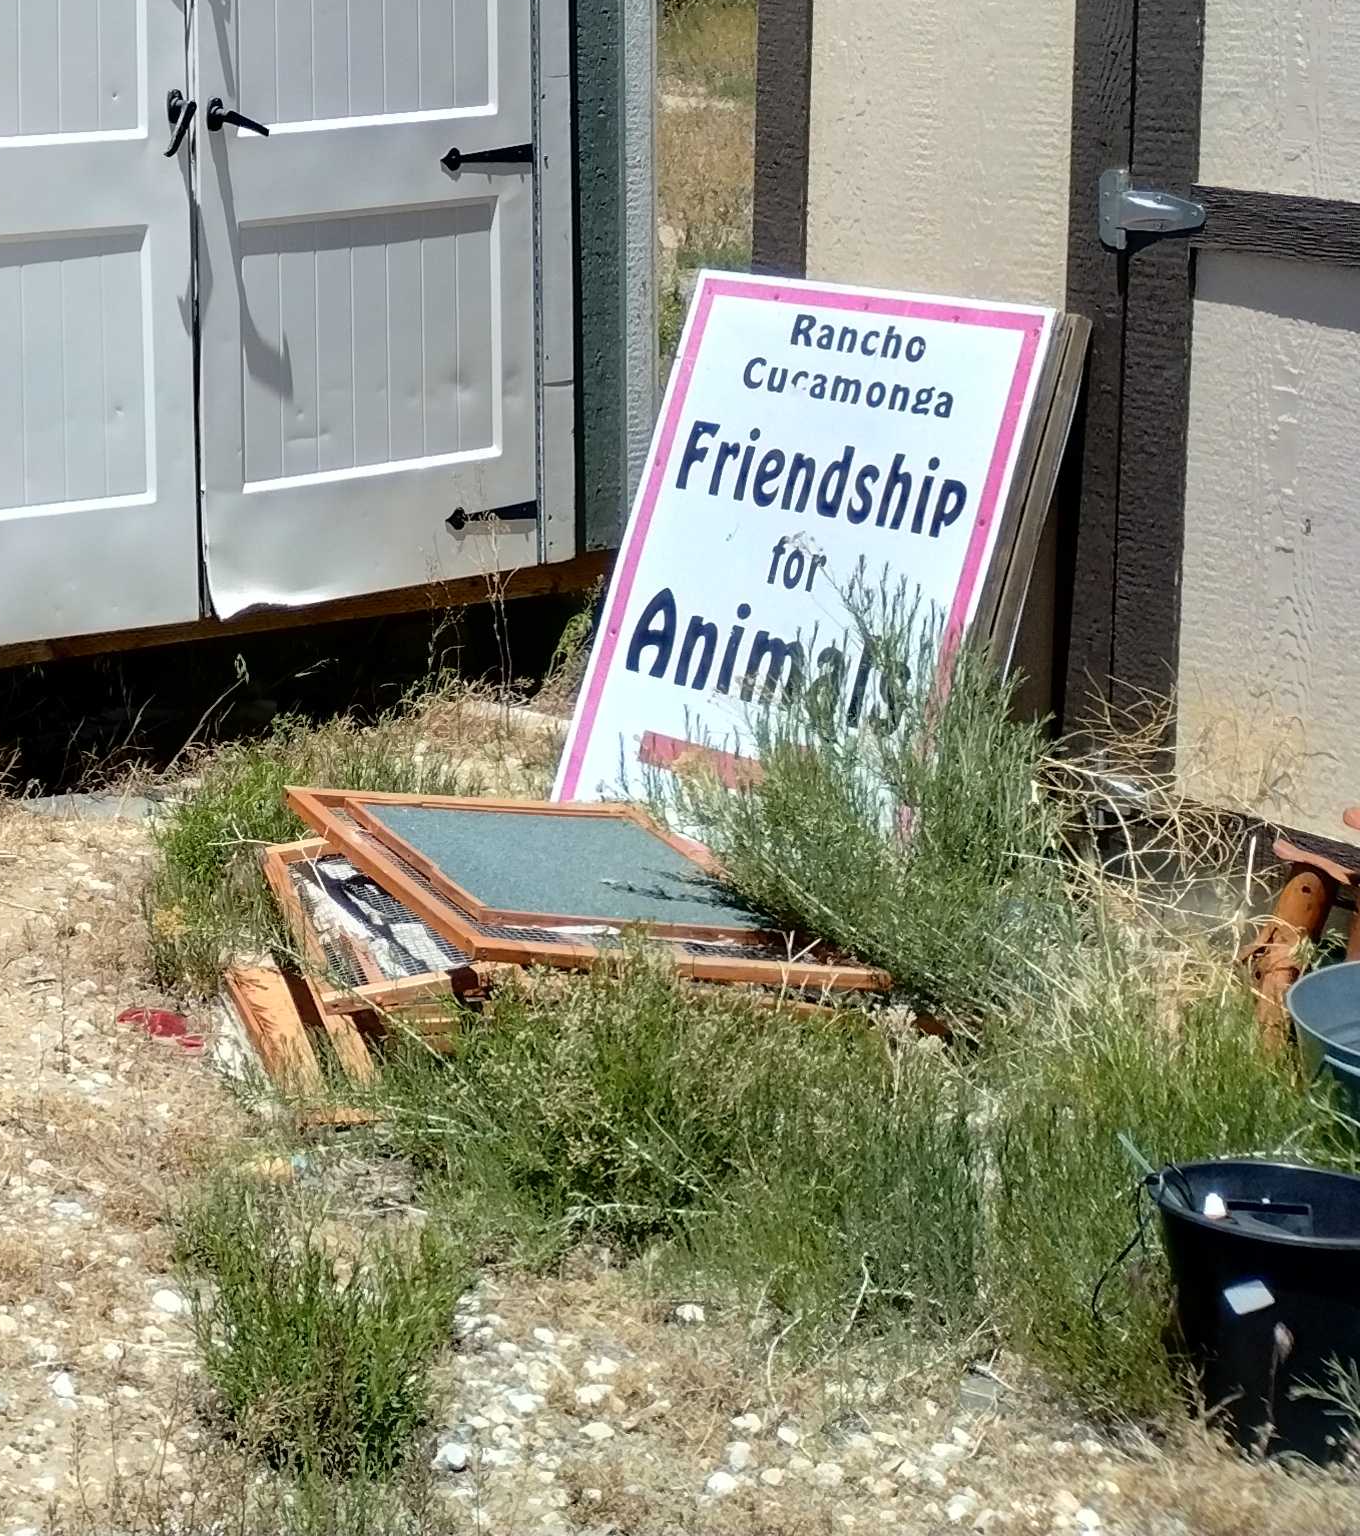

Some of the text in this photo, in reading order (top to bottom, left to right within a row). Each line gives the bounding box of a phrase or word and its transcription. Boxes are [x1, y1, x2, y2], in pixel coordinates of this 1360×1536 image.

[790, 314, 927, 363] Rancho
[743, 357, 954, 418] Cucamonga
[676, 420, 967, 537] Friendship
[767, 535, 827, 592] for
